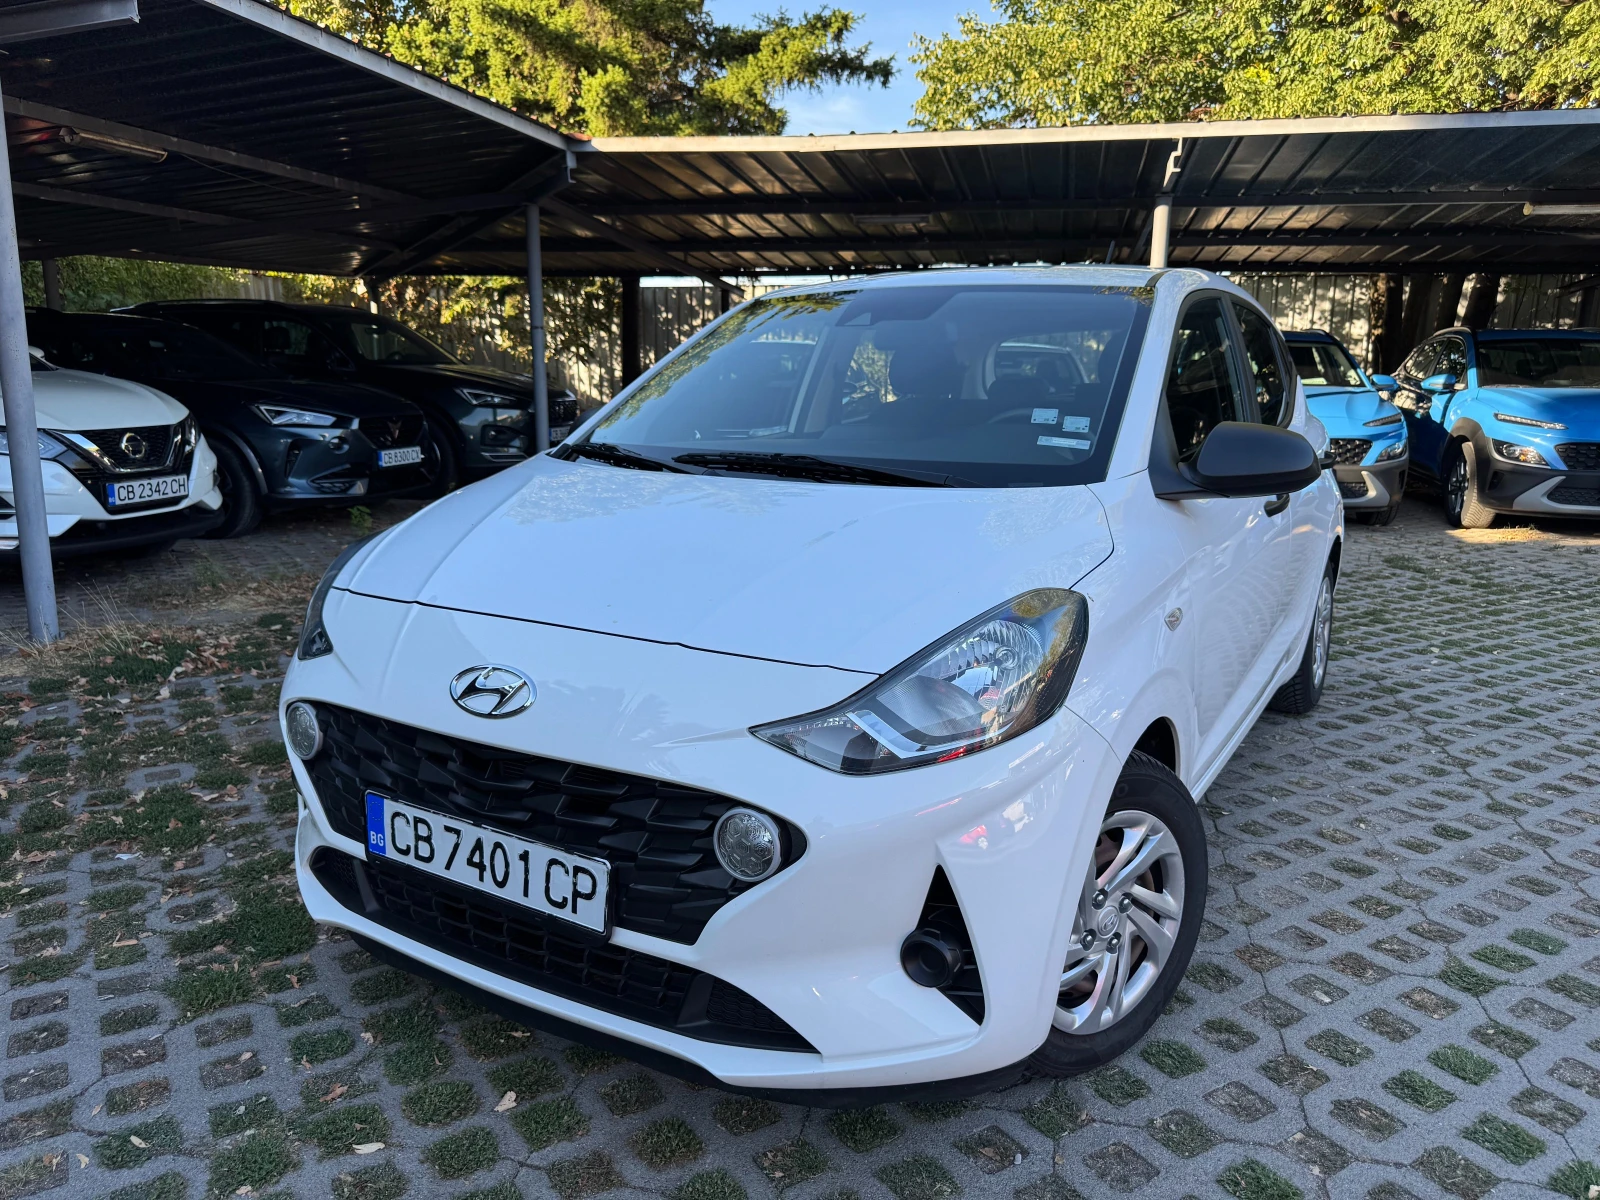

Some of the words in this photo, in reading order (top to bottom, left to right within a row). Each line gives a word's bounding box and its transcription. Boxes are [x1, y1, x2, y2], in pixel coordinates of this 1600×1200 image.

[117, 485, 135, 501] CB
[138, 480, 168, 499] 2342
[170, 477, 186, 494] CH
[370, 831, 384, 847] BG
[390, 811, 435, 863] CB
[443, 825, 530, 898] 7401
[544, 857, 598, 914] CP
